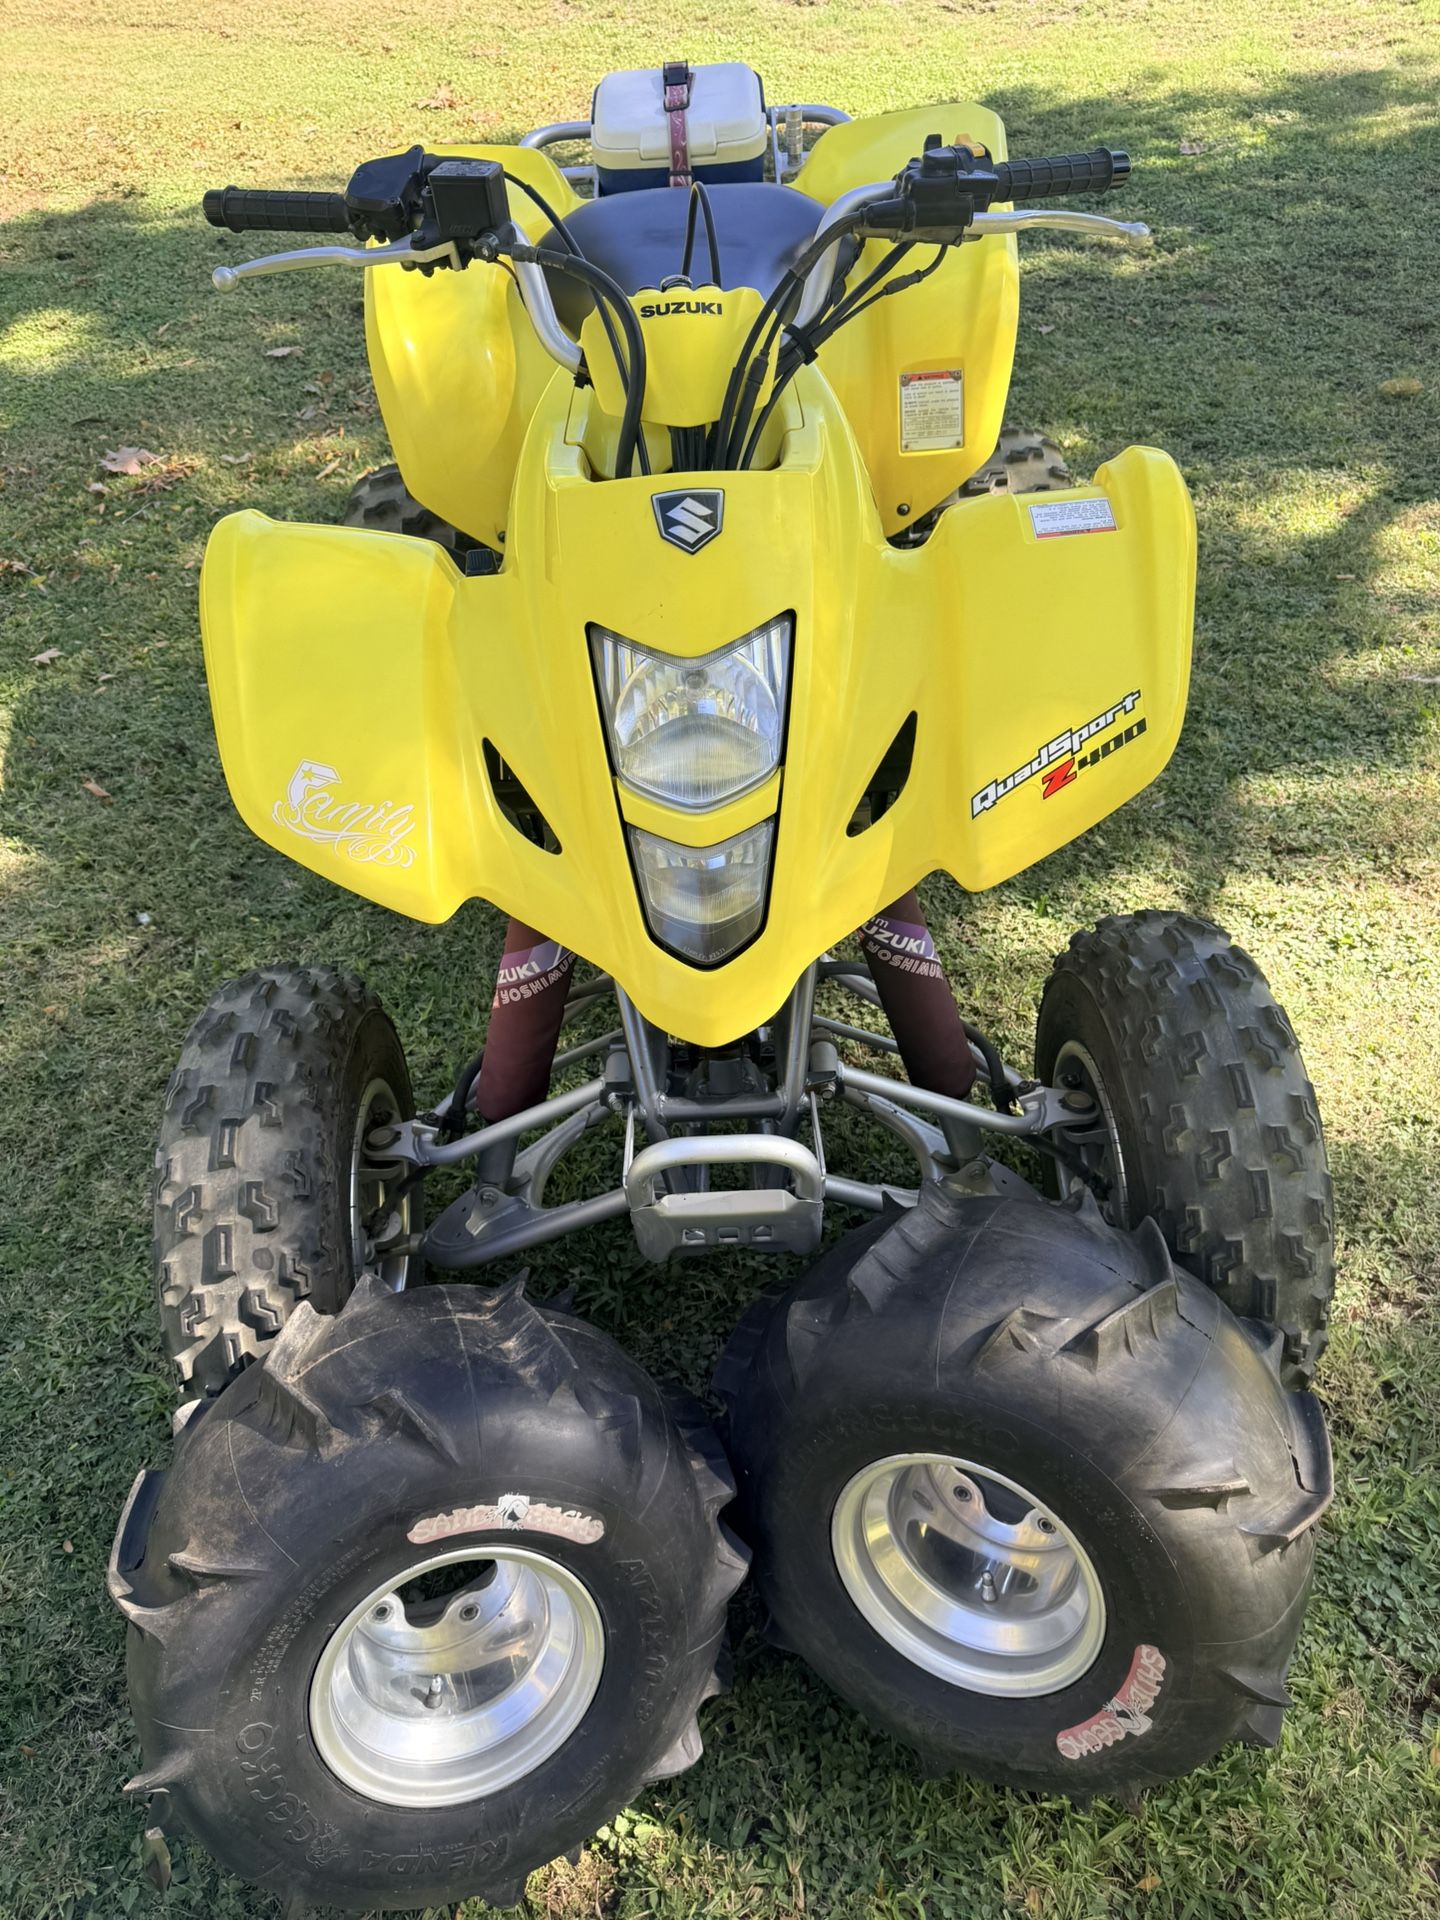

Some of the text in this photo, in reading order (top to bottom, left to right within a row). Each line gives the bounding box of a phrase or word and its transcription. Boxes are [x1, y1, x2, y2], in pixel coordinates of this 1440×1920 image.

[640, 302, 723, 318] SUZUKI
[971, 689, 1141, 820] QuadSport
[1042, 717, 1147, 800] Z400
[272, 759, 417, 868] Family
[1128, 1643, 1167, 1711] SAND
[1057, 1717, 1126, 1761] GECKO
[234, 1722, 319, 1845] GECKO
[358, 1833, 510, 1876] KENDA
